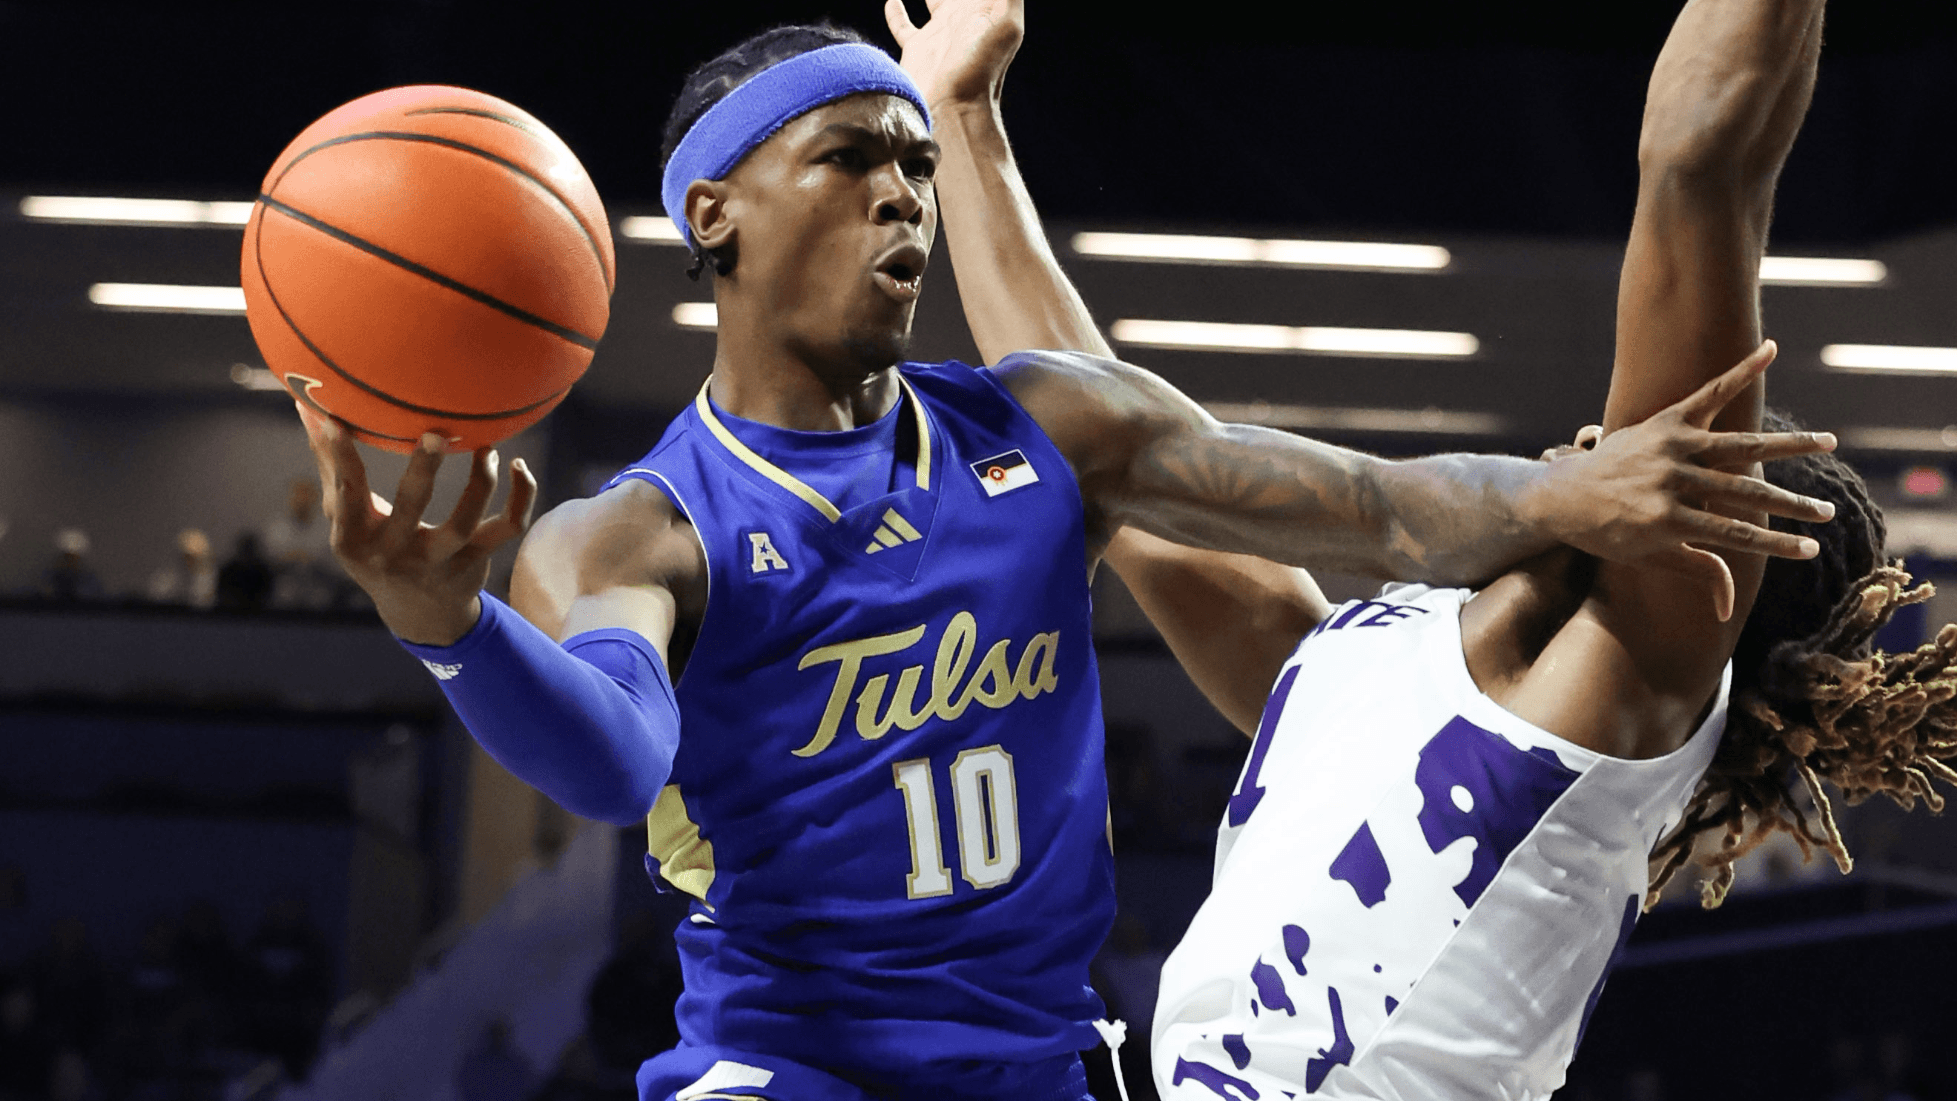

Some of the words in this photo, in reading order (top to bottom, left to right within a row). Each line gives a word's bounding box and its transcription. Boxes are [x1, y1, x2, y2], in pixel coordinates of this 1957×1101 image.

[748, 533, 789, 573] A
[791, 611, 1060, 757] Tulsa
[892, 744, 1021, 900] 10
